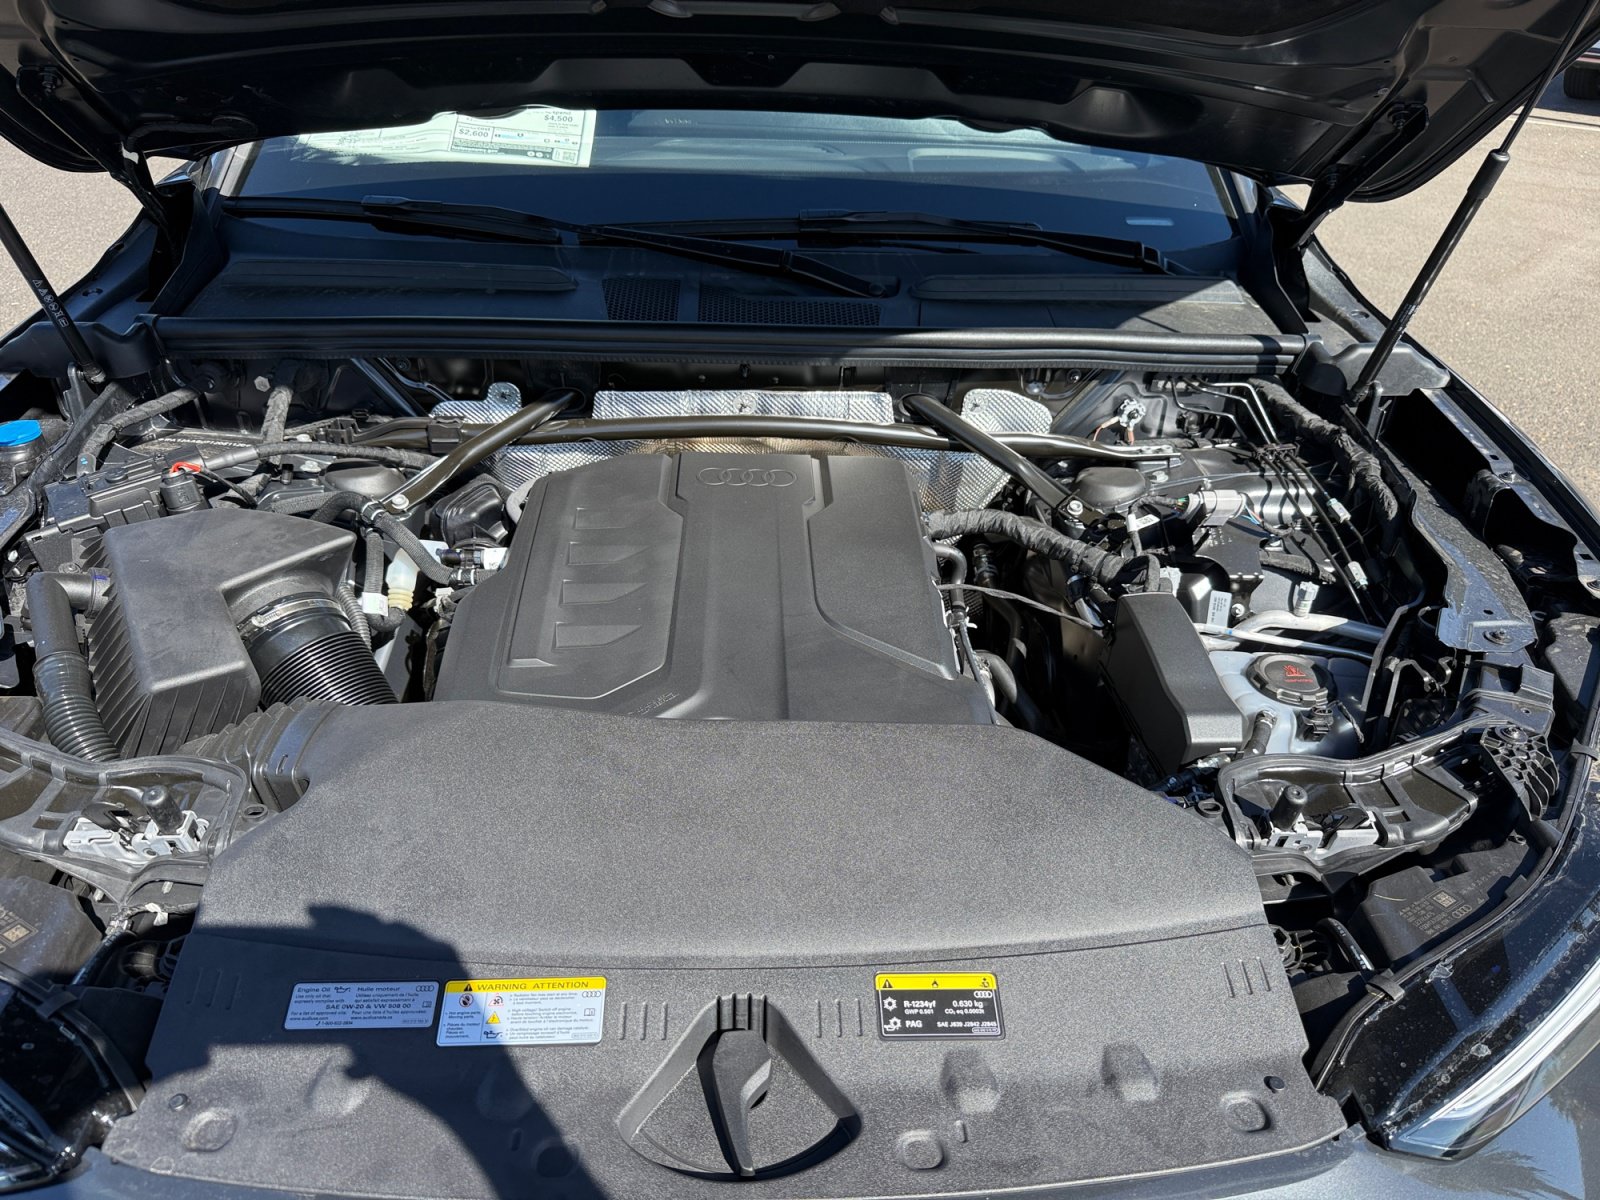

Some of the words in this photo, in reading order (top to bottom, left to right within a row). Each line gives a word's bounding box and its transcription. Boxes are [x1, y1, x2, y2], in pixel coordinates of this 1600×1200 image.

[544, 114, 573, 122] $4,500
[459, 128, 489, 137] $2,600
[533, 981, 589, 989] ATTENTION
[903, 1000, 936, 1009] R-1234yf
[952, 1000, 973, 1008] 0.630
[974, 1000, 984, 1008] kg
[905, 1020, 923, 1028] PAG
